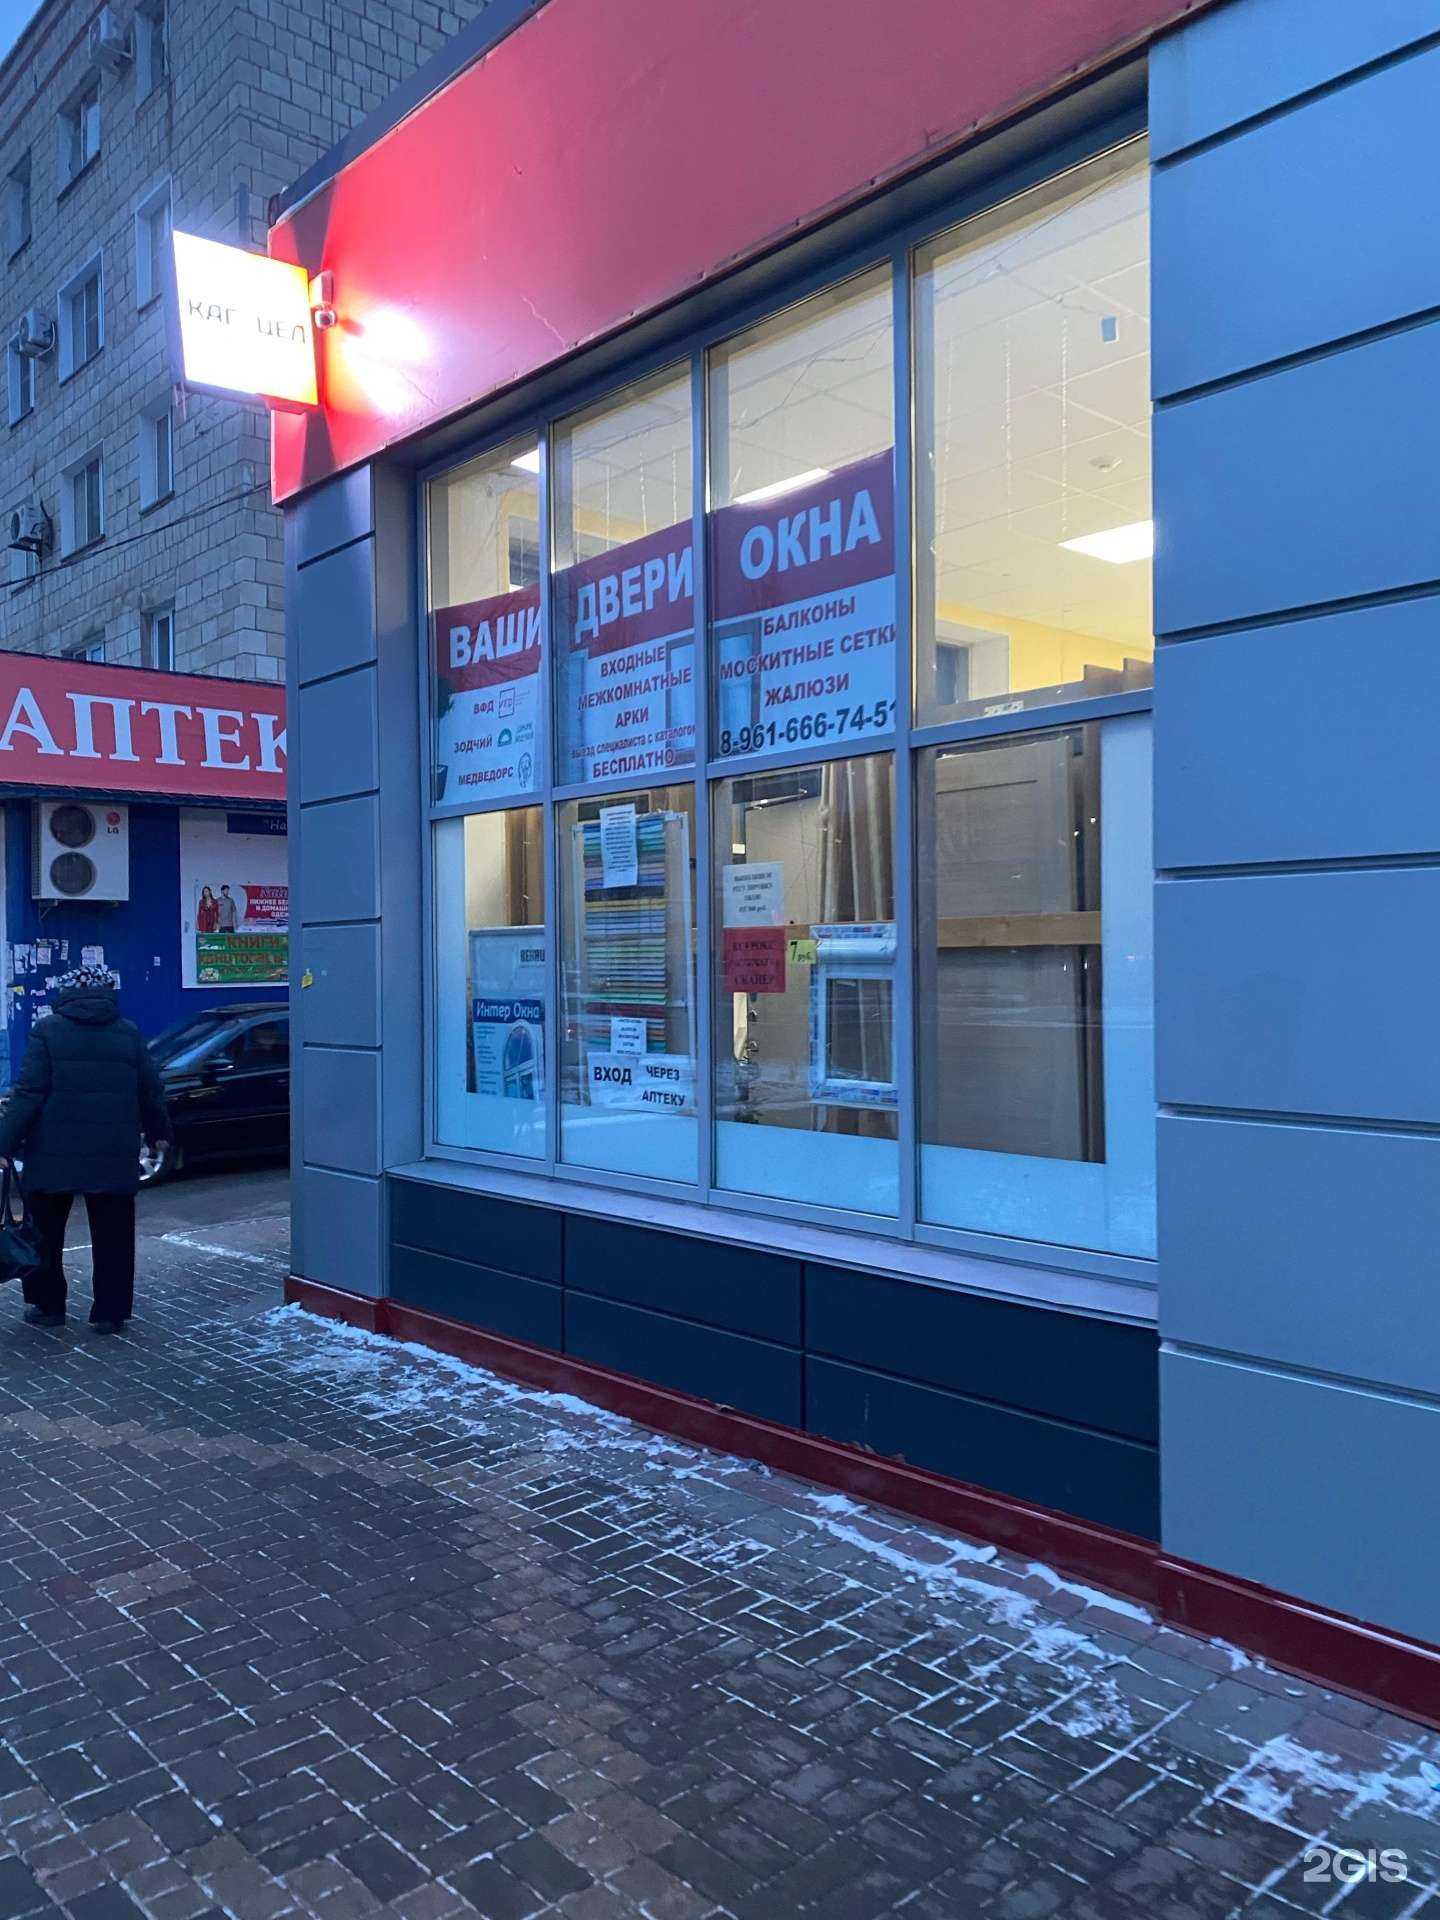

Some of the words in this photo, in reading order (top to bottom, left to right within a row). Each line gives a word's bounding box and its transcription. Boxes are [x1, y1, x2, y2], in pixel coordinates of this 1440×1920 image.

[450, 606, 541, 668] ВАШИ
[575, 546, 694, 644] ДВЕРИ
[740, 489, 881, 580] ОКНА
[763, 597, 855, 635] БАЛКОНЫ
[600, 646, 665, 677] ВХОДНЫЕ
[720, 639, 834, 680] МОСКИТНЫЕ
[577, 668, 691, 712] МЕЖКОМНАТНЫЕ
[765, 672, 849, 707] ЖАЛЮЗИ
[473, 701, 494, 714] ВФД
[615, 707, 649, 728] АРКИ
[0, 687, 287, 773] АПТЕК
[720, 699, 896, 754] 8-961-666-74-5
[454, 734, 493, 753] ЗОДЧИЙ
[592, 748, 674, 778] БЕСПЛАТНО
[477, 1001, 510, 1021] Интер
[514, 1002, 540, 1019] Окна
[593, 1066, 633, 1086] ВХОД
[646, 1065, 680, 1081] ЧЕРЕЗ
[642, 1090, 685, 1107] АПТЕКУ
